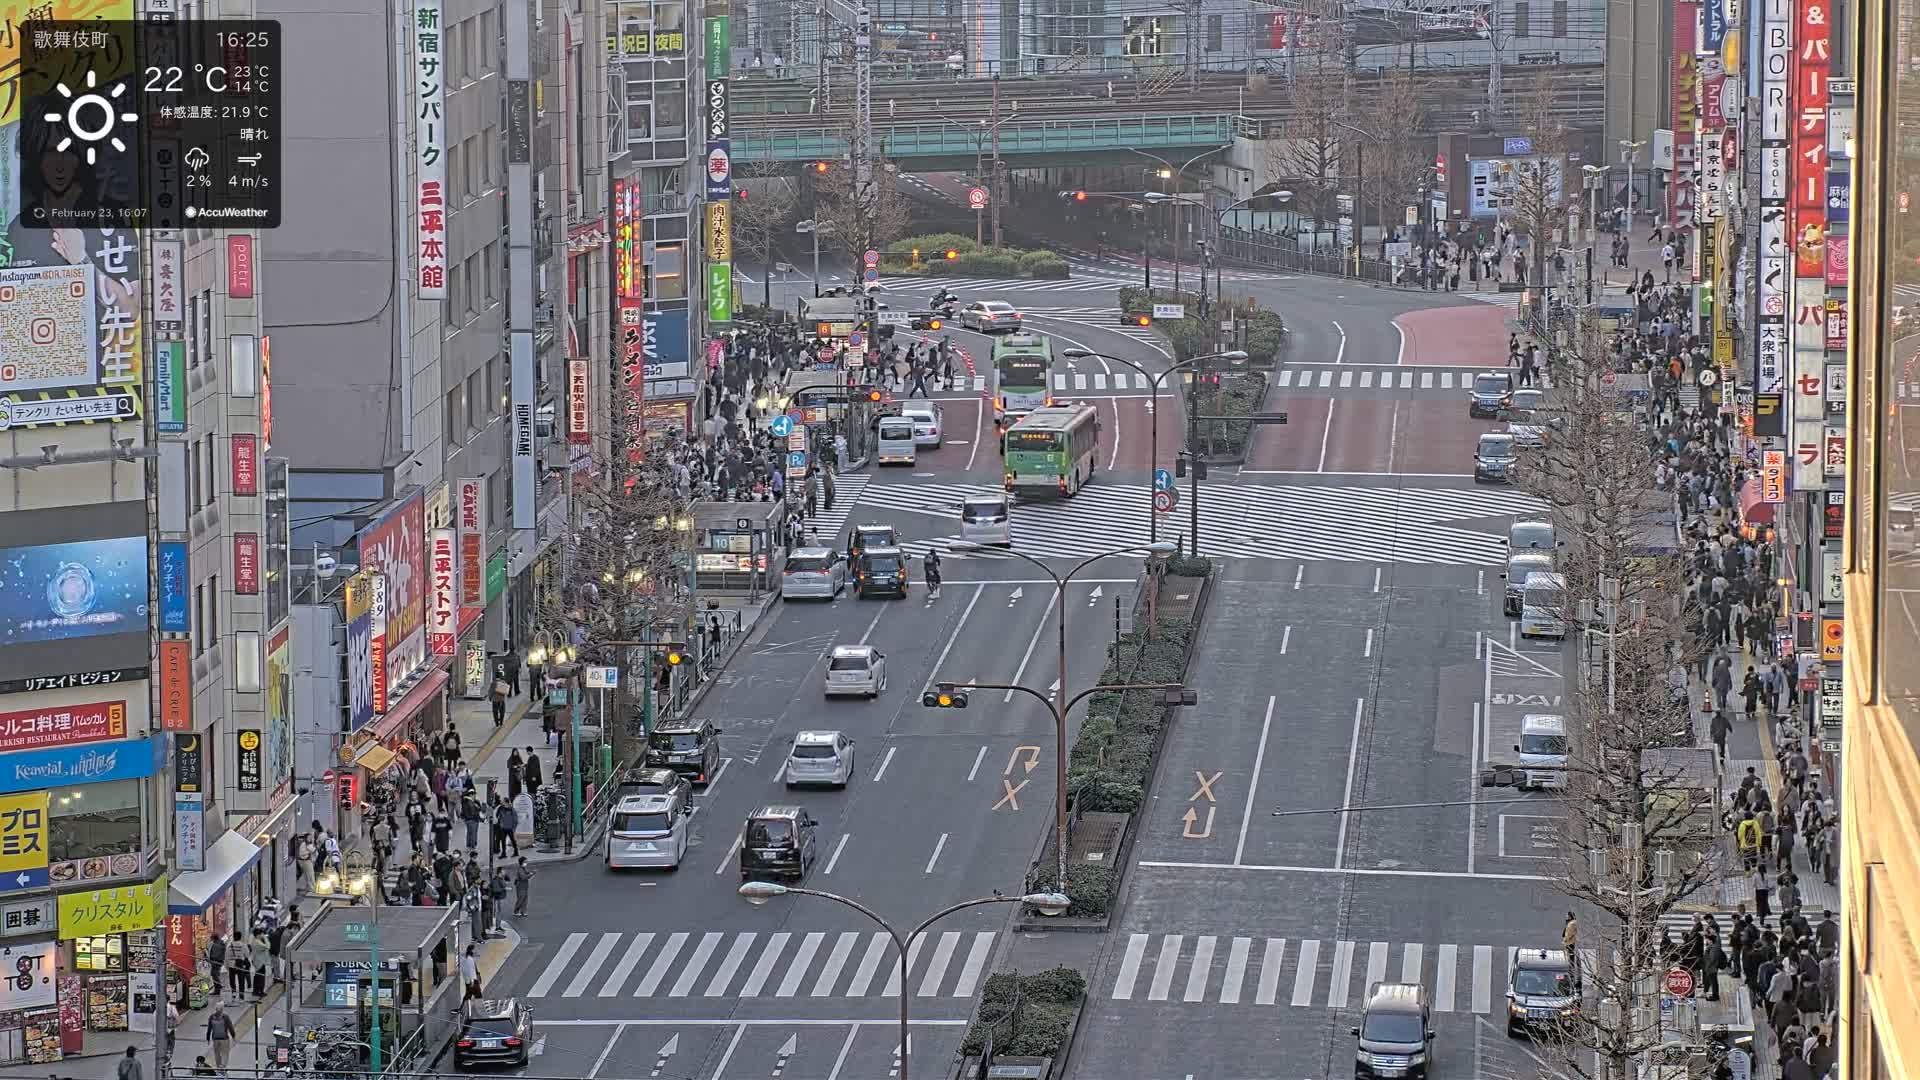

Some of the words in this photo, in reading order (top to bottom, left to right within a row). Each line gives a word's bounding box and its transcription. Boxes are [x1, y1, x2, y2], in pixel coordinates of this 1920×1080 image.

[655, 33, 683, 51] 夜間
[418, 8, 441, 167] 新宿サンパーク
[1708, 84, 1720, 117] アコム
[710, 81, 725, 135] もつなべ
[710, 158, 727, 174] 薬
[420, 181, 444, 289] 三平本館
[712, 204, 726, 260] 肉汁水餃子
[711, 272, 726, 311] レイク
[160, 322, 177, 330] 3F
[622, 328, 640, 386] ラーメン
[1761, 327, 1776, 379] 大衆酒場
[159, 351, 170, 411] FamilyMart
[1797, 304, 1823, 466] パセラ
[56, 401, 113, 416] たいせい先生
[1831, 402, 1845, 412] 5F
[516, 404, 530, 457] HOMEGAME
[237, 447, 251, 485] 龍生堂
[463, 484, 474, 528] GAME
[1831, 494, 1843, 503] 3F
[715, 537, 728, 549] 10
[163, 551, 174, 602] ゲウチャイ
[240, 545, 253, 580] 龍生堂
[435, 539, 451, 626] 三平ストア
[27, 732, 71, 745] RESTAURANT
[1, 807, 41, 833] プロ
[3, 832, 41, 855] ミス
[6, 908, 41, 929] 囲碁
[71, 901, 144, 924] クリスタル
[328, 988, 345, 1001] 12
